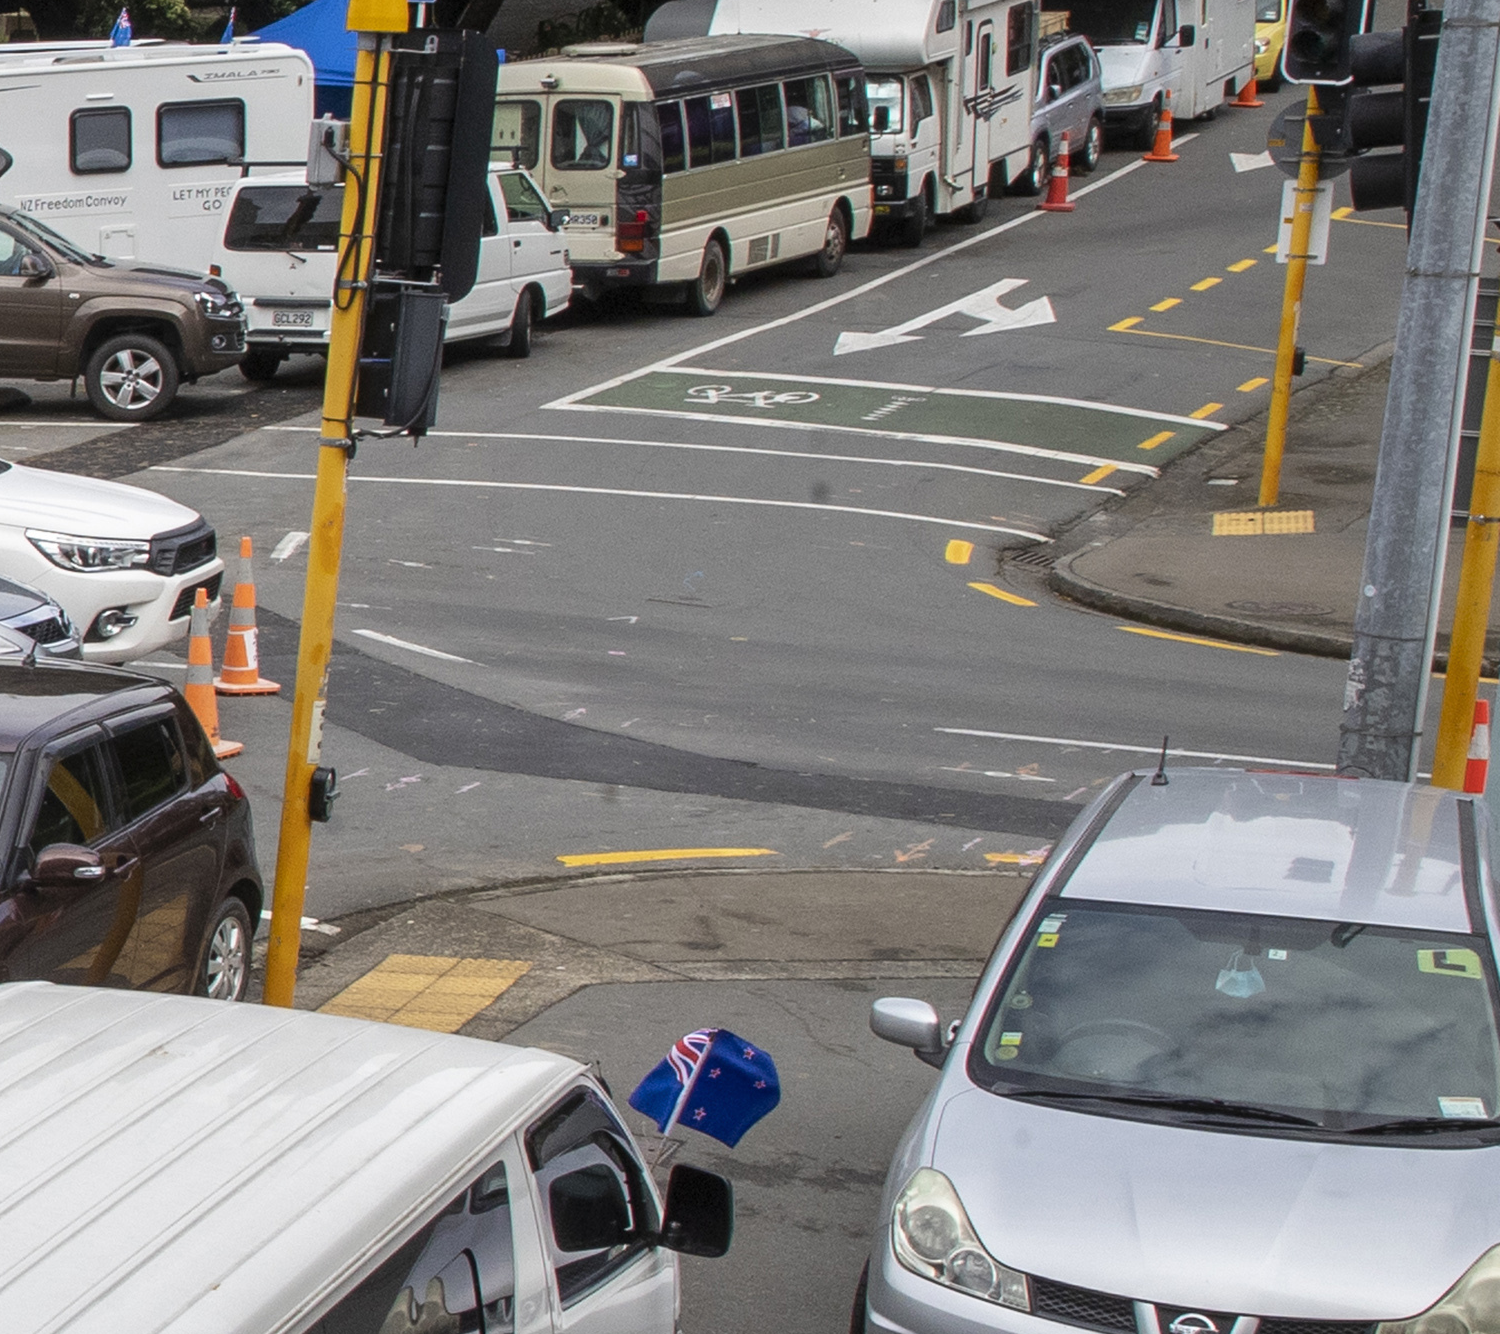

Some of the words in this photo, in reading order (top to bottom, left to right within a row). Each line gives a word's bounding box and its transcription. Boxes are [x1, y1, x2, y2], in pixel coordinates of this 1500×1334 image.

[173, 189, 192, 200] LET
[196, 189, 212, 199] MY
[202, 199, 222, 211] GO
[274, 312, 312, 324] GCL292
